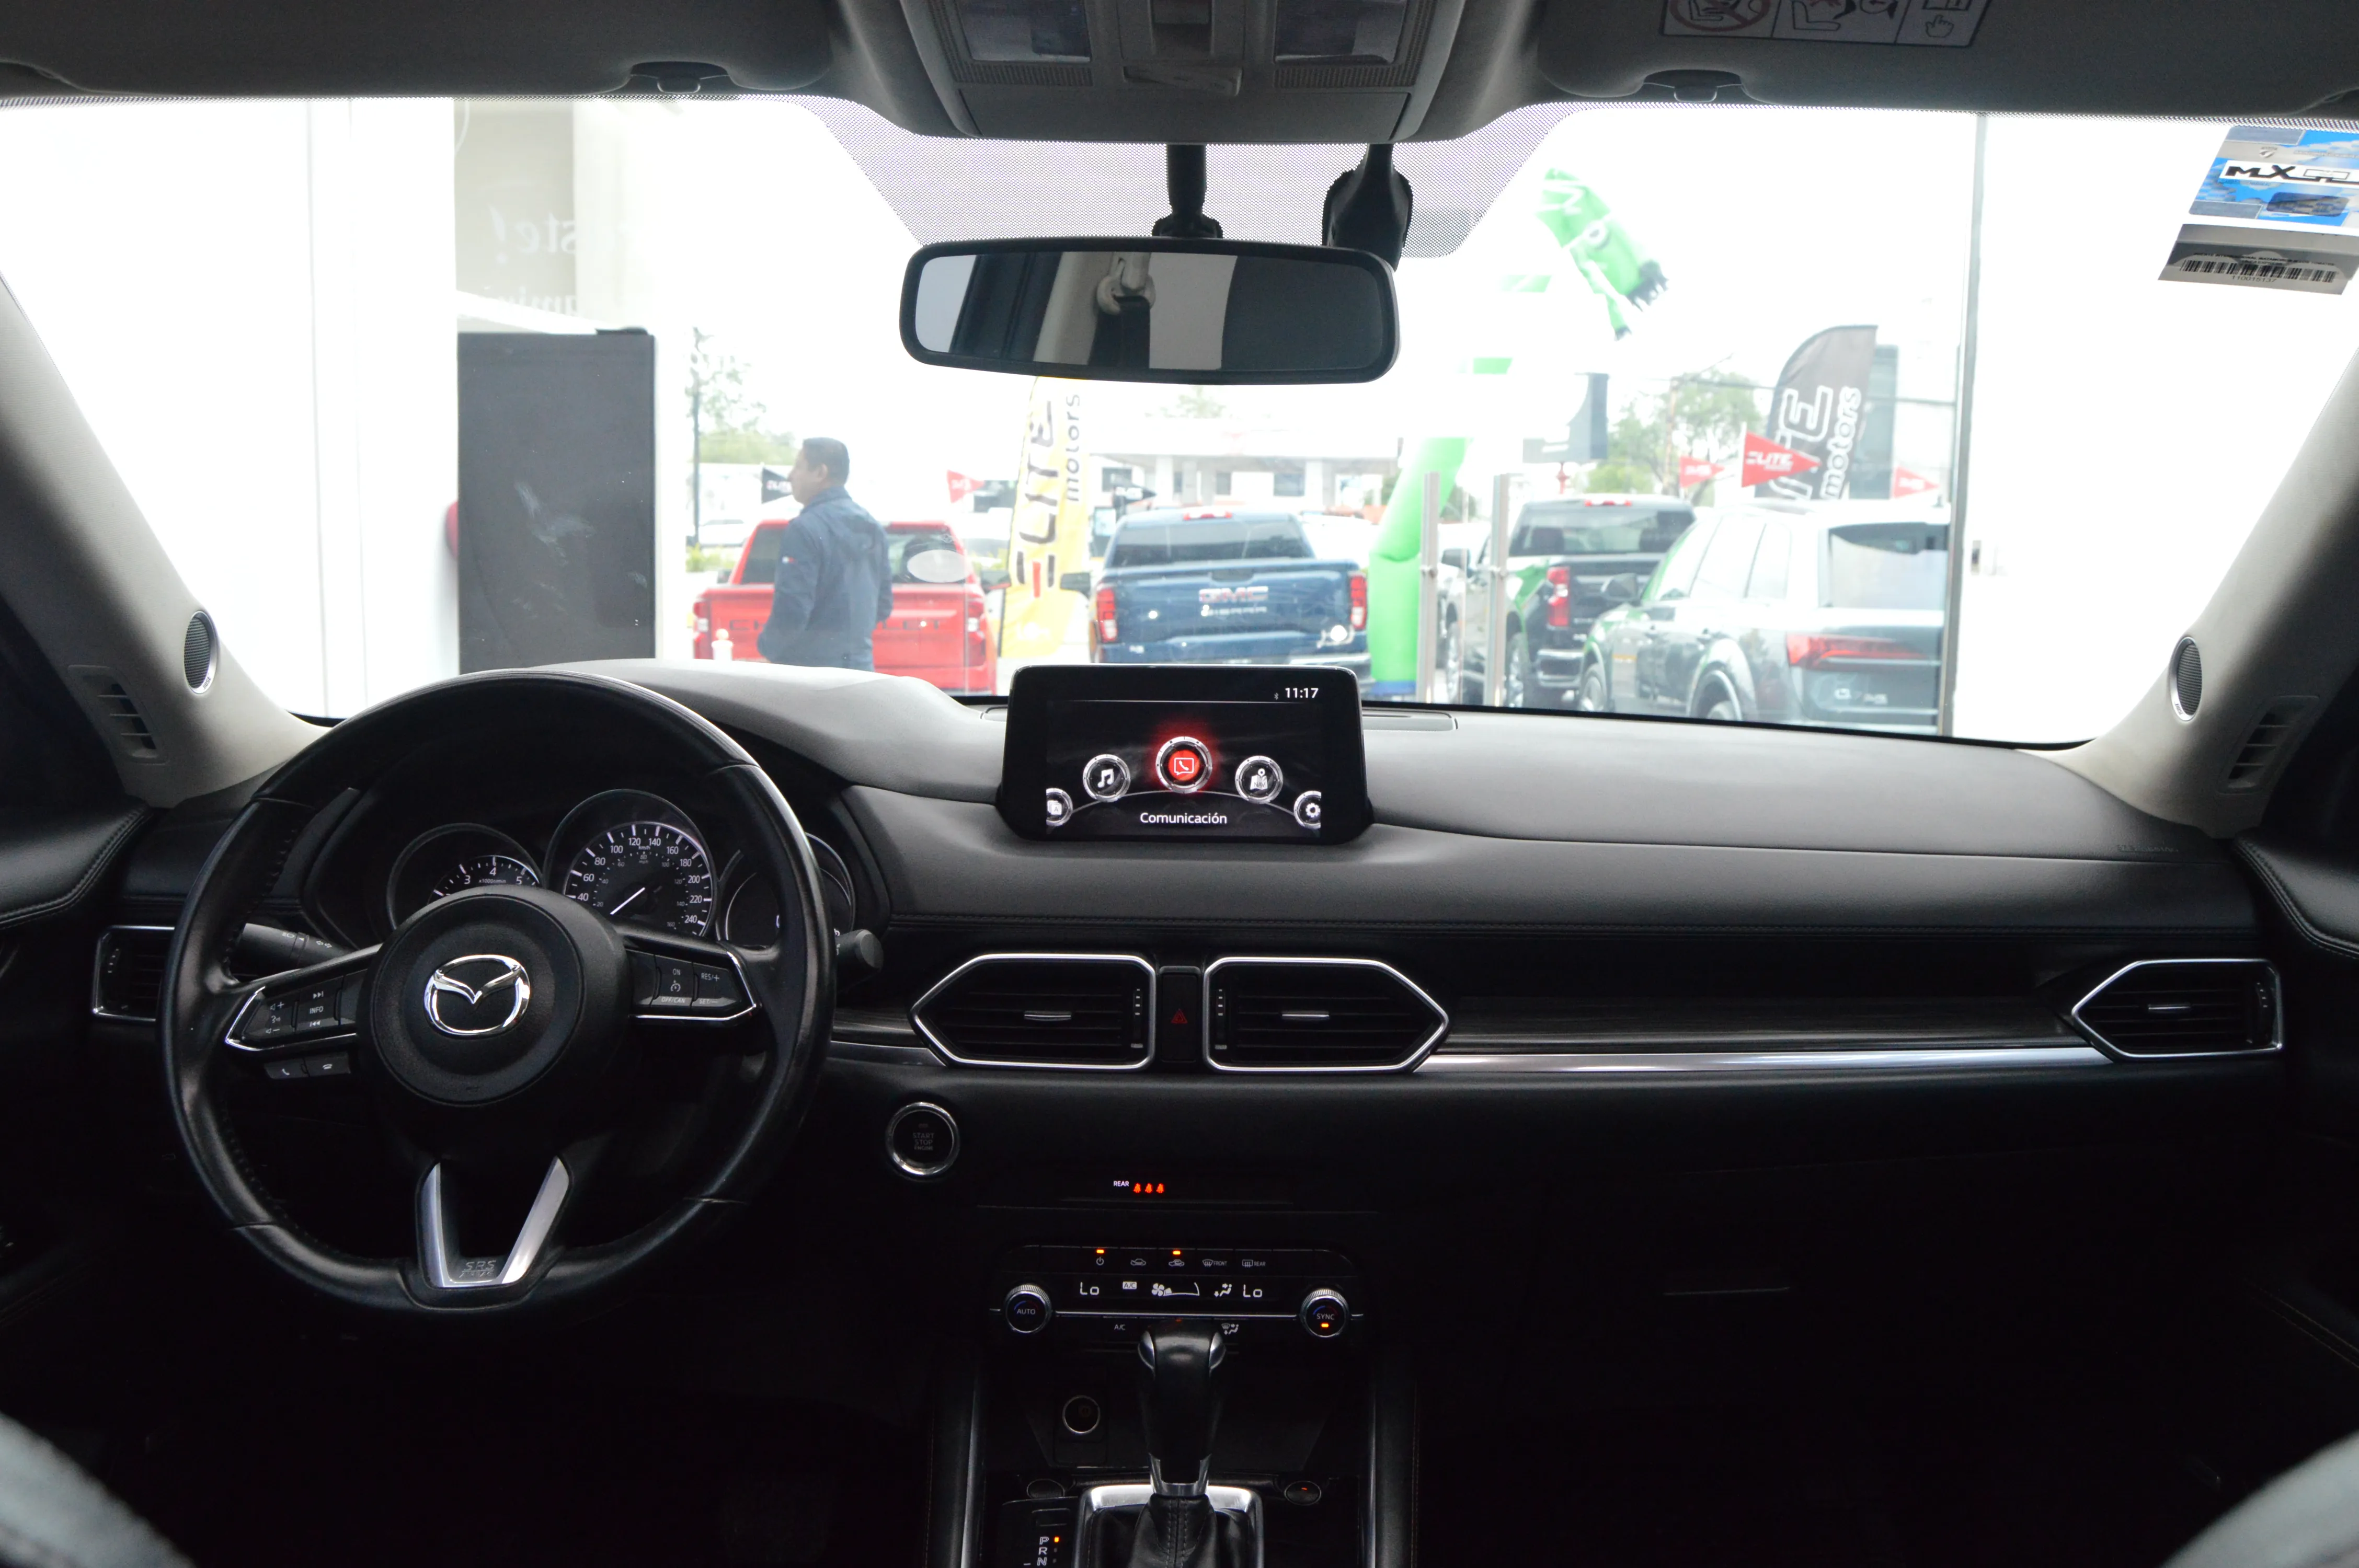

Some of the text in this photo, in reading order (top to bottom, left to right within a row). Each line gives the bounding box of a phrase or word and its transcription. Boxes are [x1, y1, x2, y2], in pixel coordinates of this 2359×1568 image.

[1820, 385, 1861, 500] motors
[1747, 452, 1793, 466] ELITE
[1016, 401, 1058, 598] ELITE
[1199, 586, 1268, 603] GMC
[1285, 687, 1319, 698] 11:17
[1140, 812, 1227, 824] Comunicación
[648, 838, 661, 846] 140
[610, 845, 623, 854] 100
[667, 846, 679, 855] 160
[594, 857, 606, 866] 80
[680, 859, 692, 867] 180
[489, 867, 496, 876] 4
[464, 875, 471, 884] 3
[516, 876, 522, 885] 5
[583, 873, 594, 882] 60
[577, 893, 589, 901] 40
[310, 1006, 324, 1014] INFO
[1080, 1282, 1100, 1295] Lo
[1243, 1284, 1263, 1297] Lo
[1039, 1536, 1049, 1545] P
[1038, 1547, 1048, 1555] R
[1037, 1557, 1047, 1566] N
